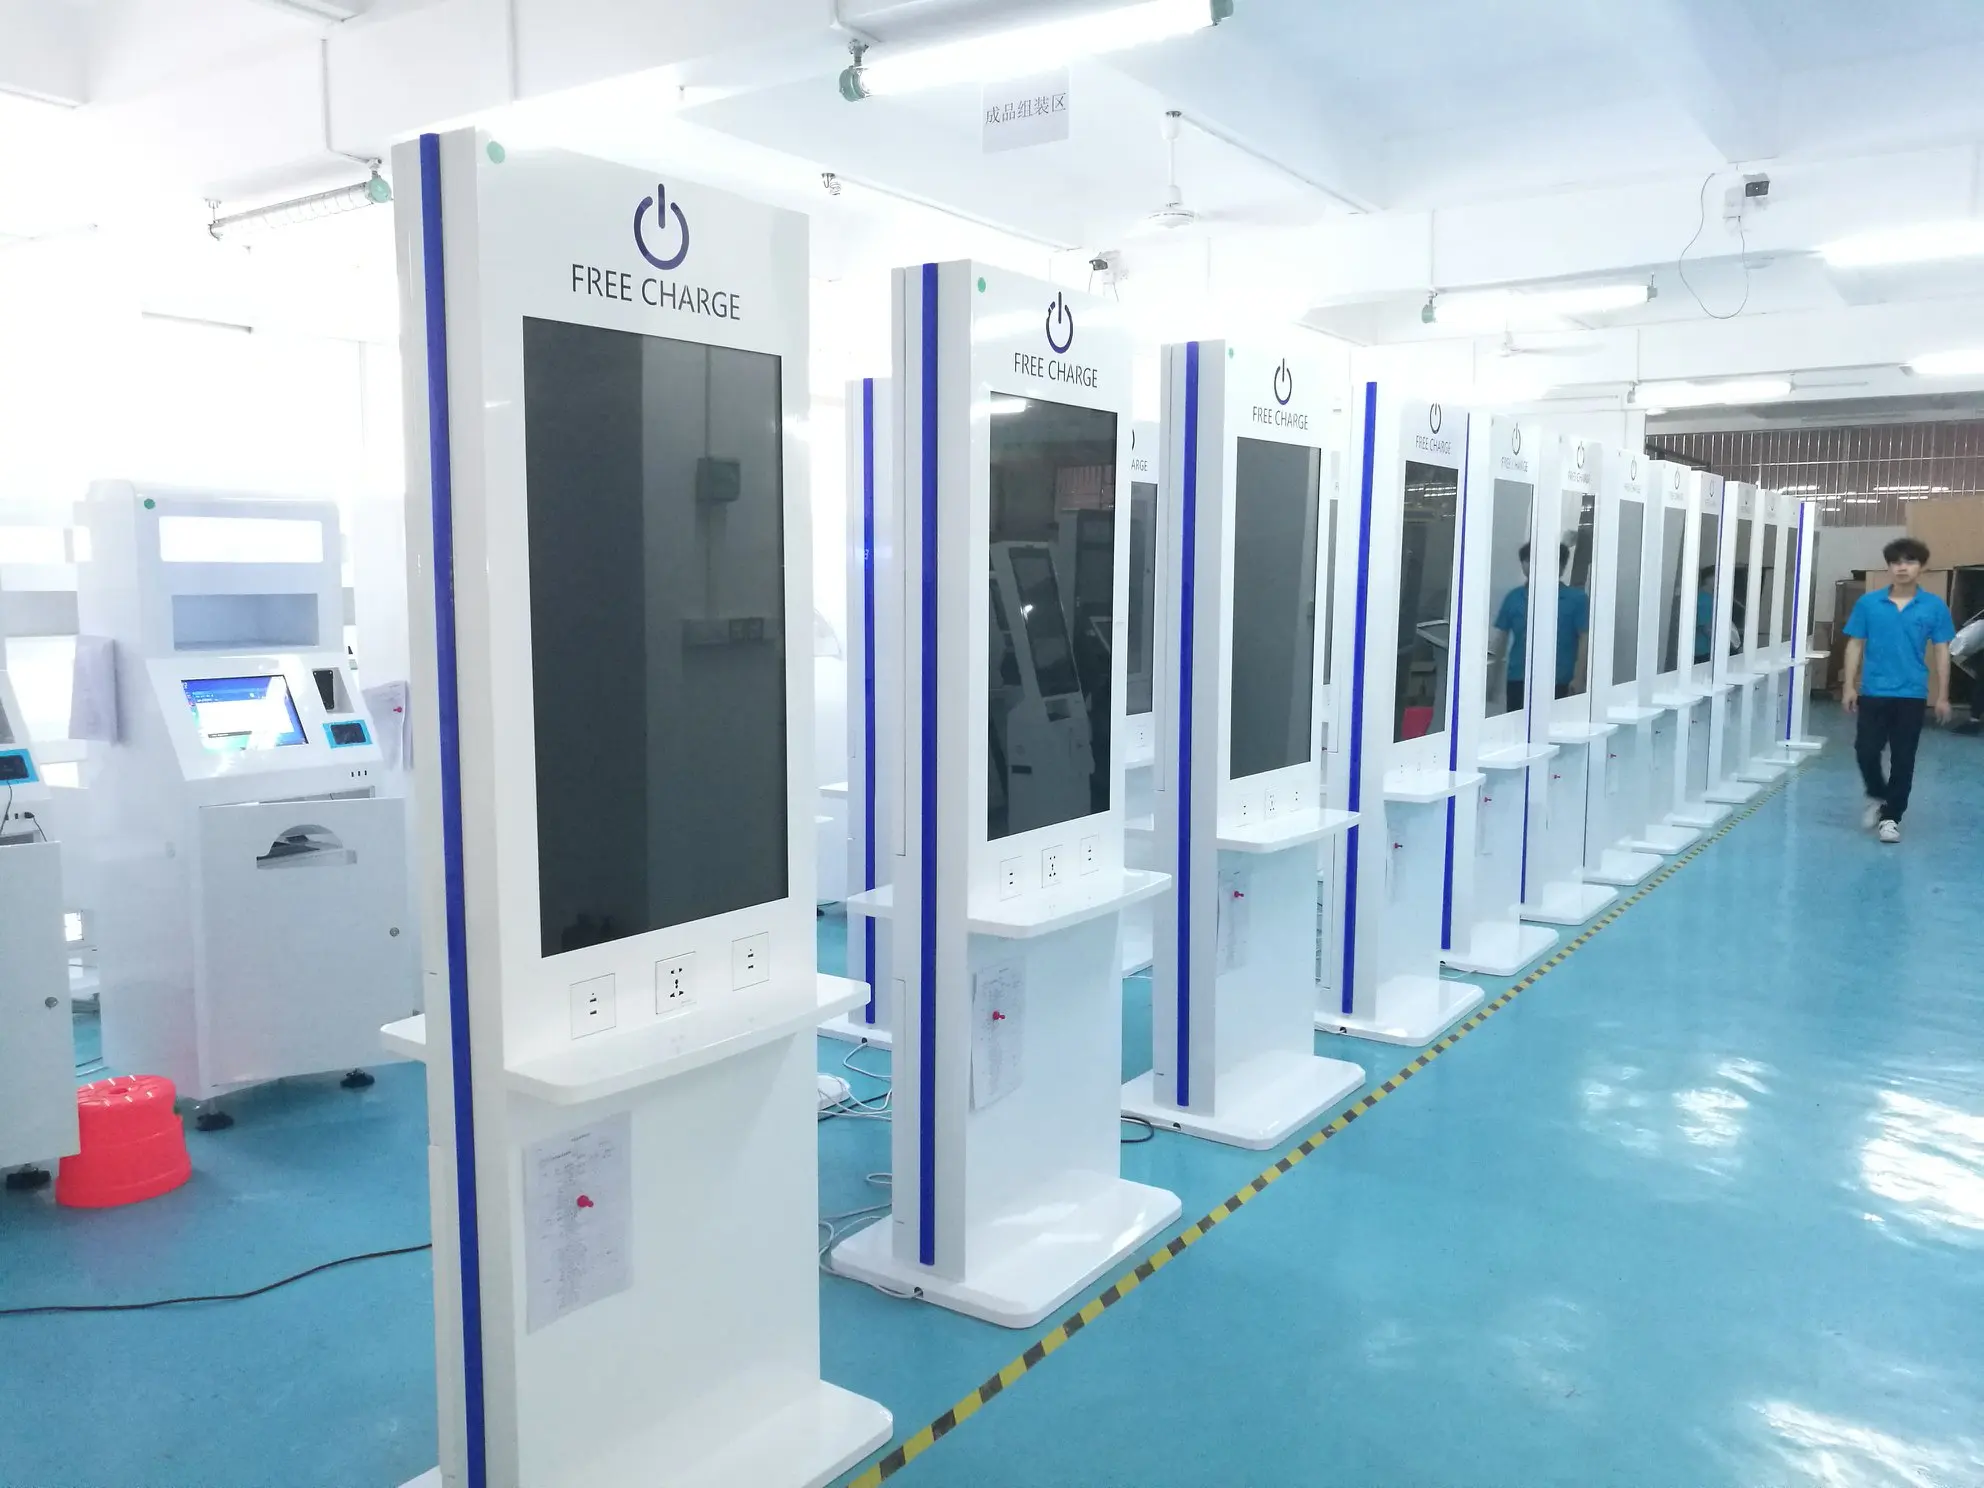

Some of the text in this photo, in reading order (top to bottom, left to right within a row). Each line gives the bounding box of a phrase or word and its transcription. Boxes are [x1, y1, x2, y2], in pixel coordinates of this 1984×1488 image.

[985, 92, 1067, 125] 成品组装区
[572, 263, 741, 320] FREE CHARGE
[1014, 352, 1098, 388] FREE CHARGE
[1252, 406, 1309, 431] FREE CHARGE
[1415, 435, 1429, 450] FREE
[1130, 459, 1148, 472] ARGE
